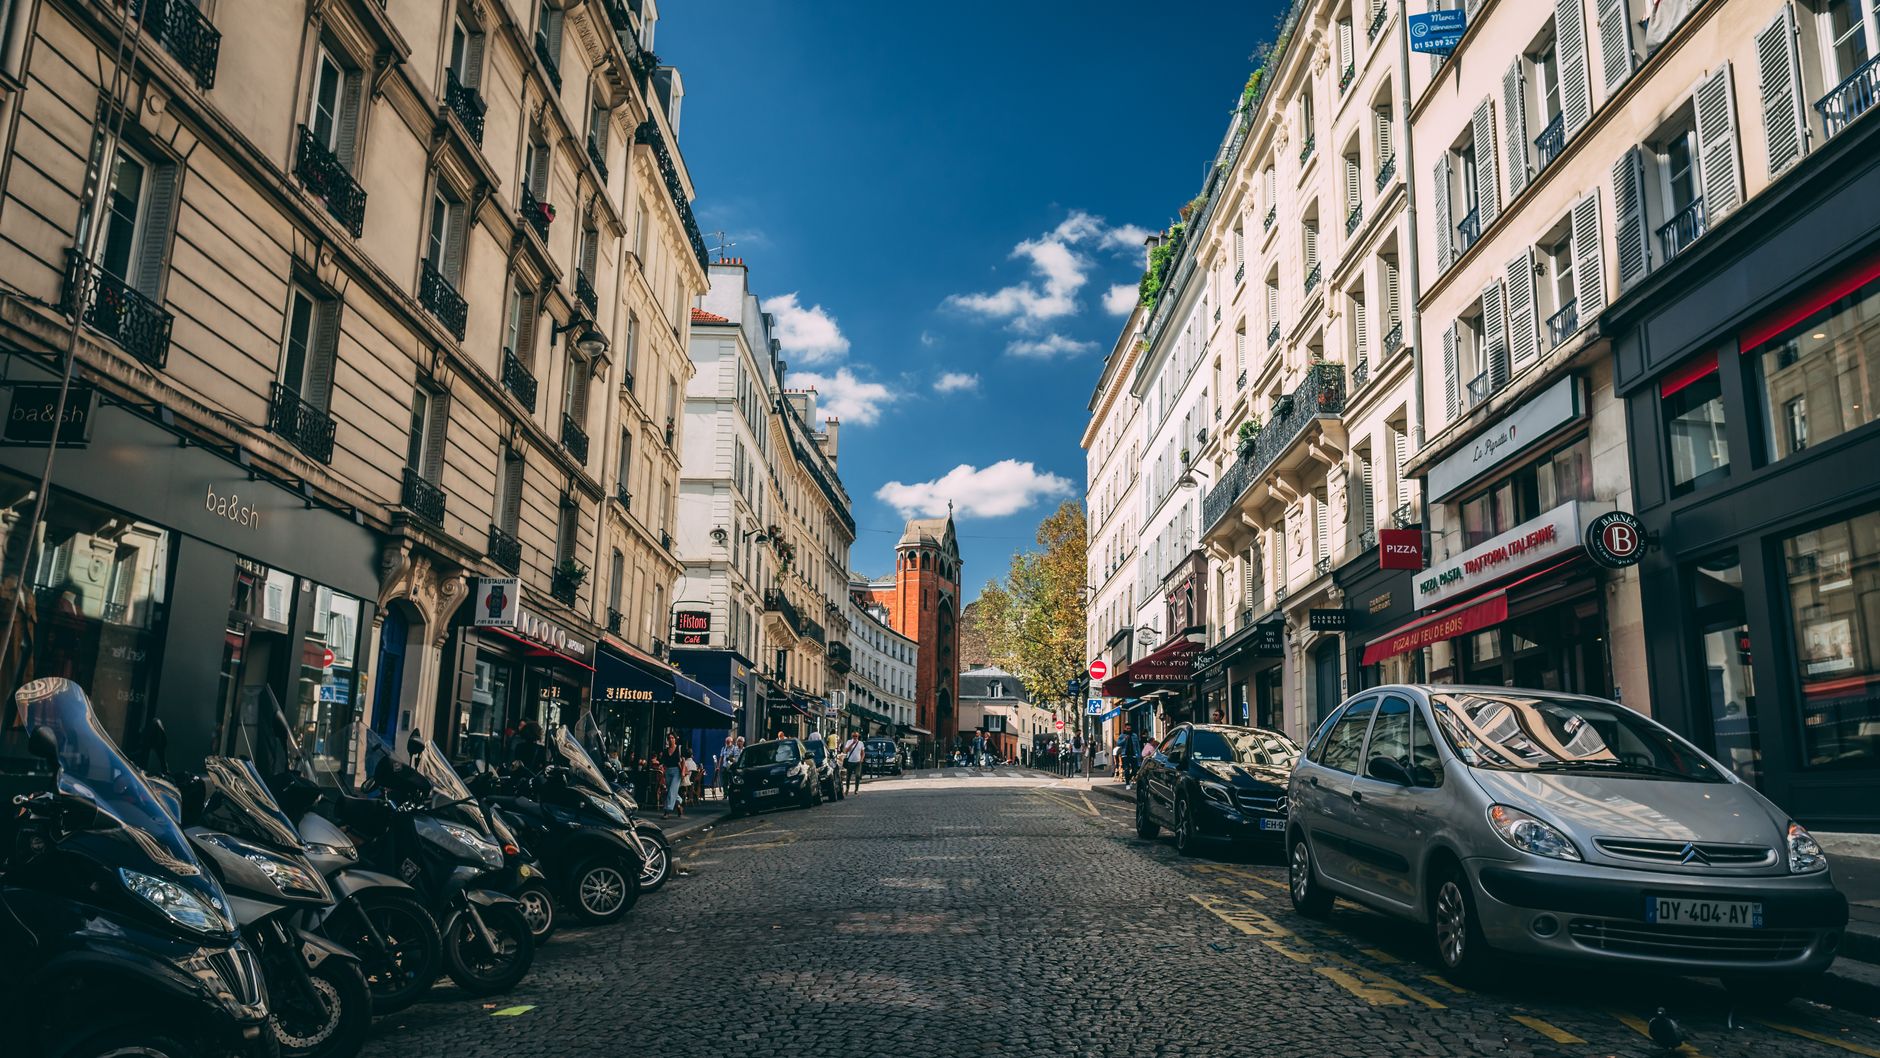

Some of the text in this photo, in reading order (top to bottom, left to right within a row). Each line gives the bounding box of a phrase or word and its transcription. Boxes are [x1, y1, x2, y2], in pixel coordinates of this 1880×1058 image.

[206, 483, 259, 530] ba&sh
[1601, 514, 1638, 528] BARNES
[1386, 545, 1418, 554] PIZZA
[684, 612, 707, 629] Fistons
[522, 612, 566, 650] NAOKO
[684, 635, 701, 644] Café
[1392, 636, 1409, 653] PIZZA
[1434, 623, 1444, 639] DE
[1445, 617, 1463, 635] BOIS
[619, 688, 654, 700] Fistons
[1660, 901, 1749, 924] DY-404-AY
